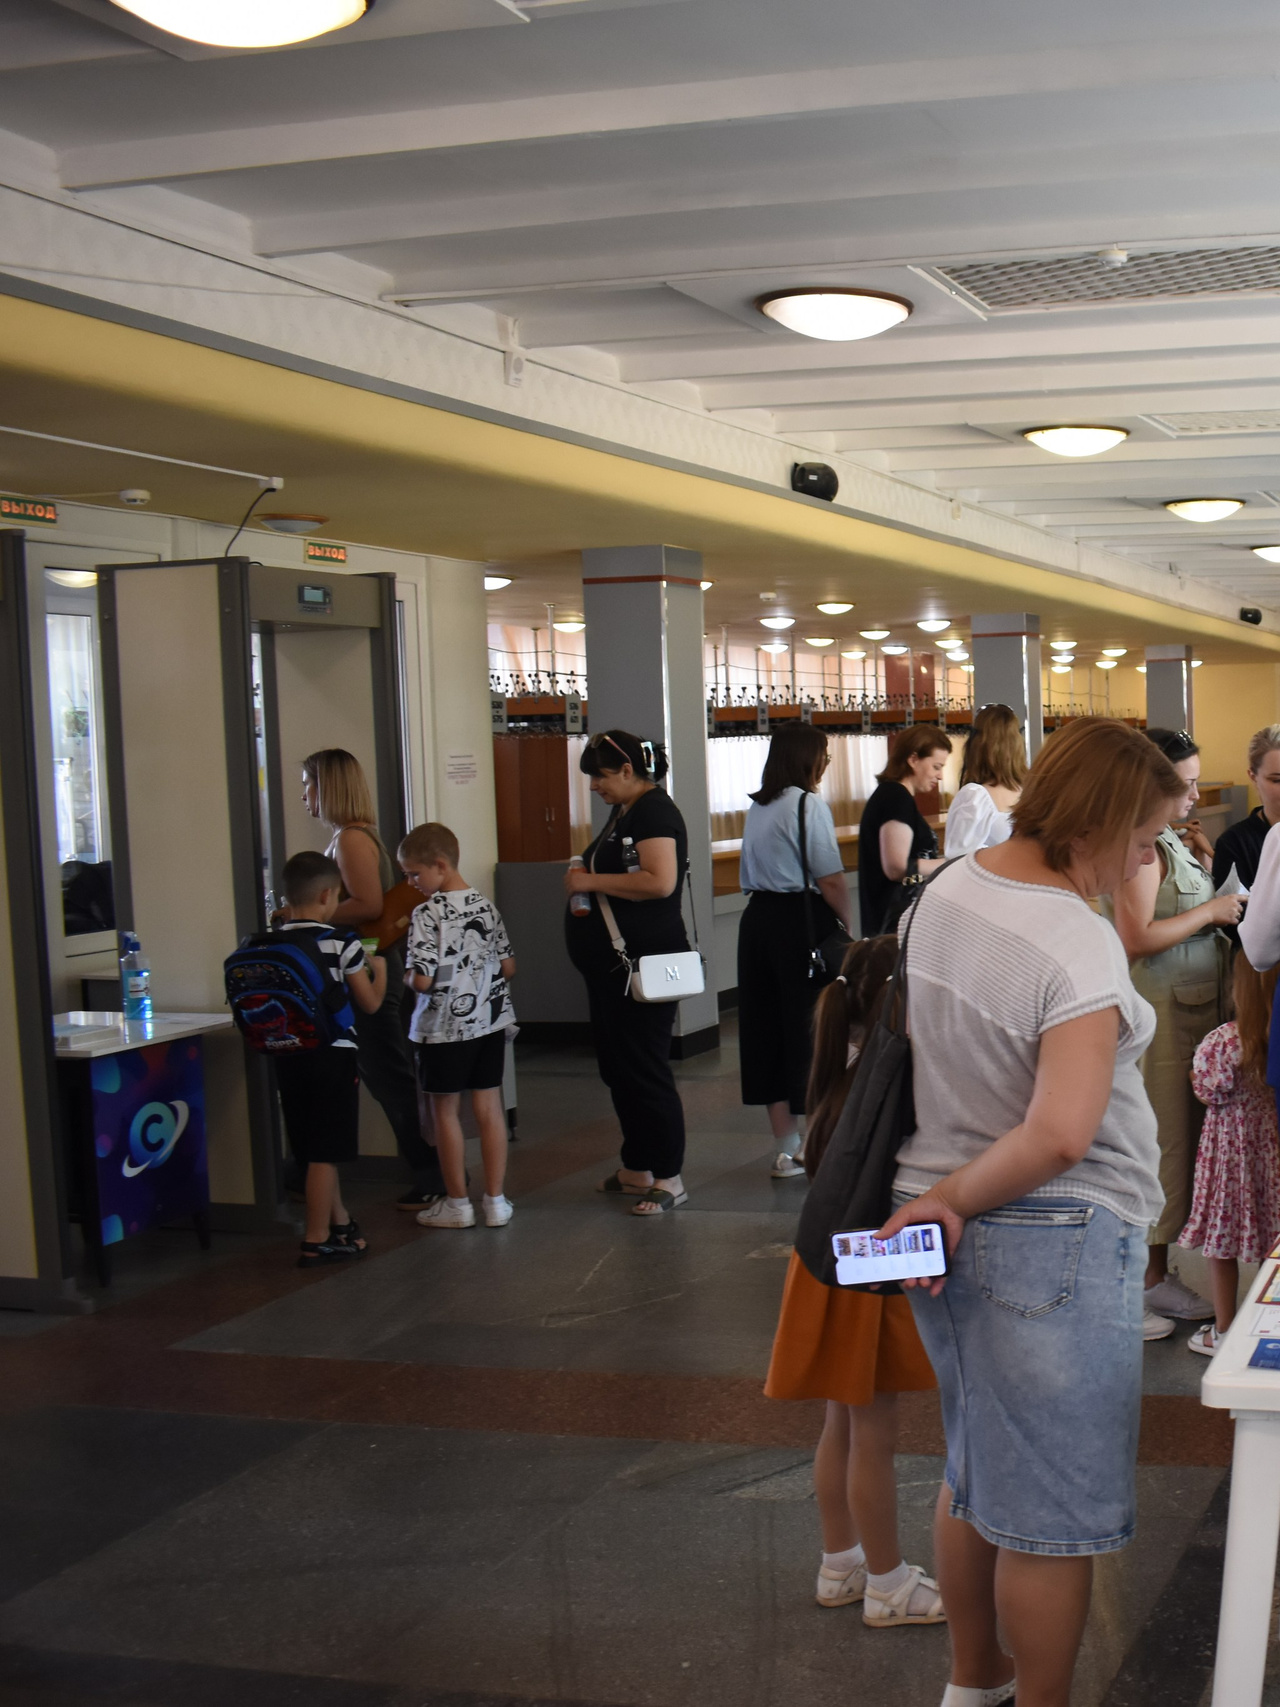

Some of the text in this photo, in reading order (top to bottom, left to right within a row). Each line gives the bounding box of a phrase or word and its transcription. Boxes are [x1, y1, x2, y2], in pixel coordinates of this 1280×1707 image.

[1, 500, 57, 520] ВЫХОД
[308, 545, 346, 561] ВЫХОД
[665, 965, 681, 982] M
